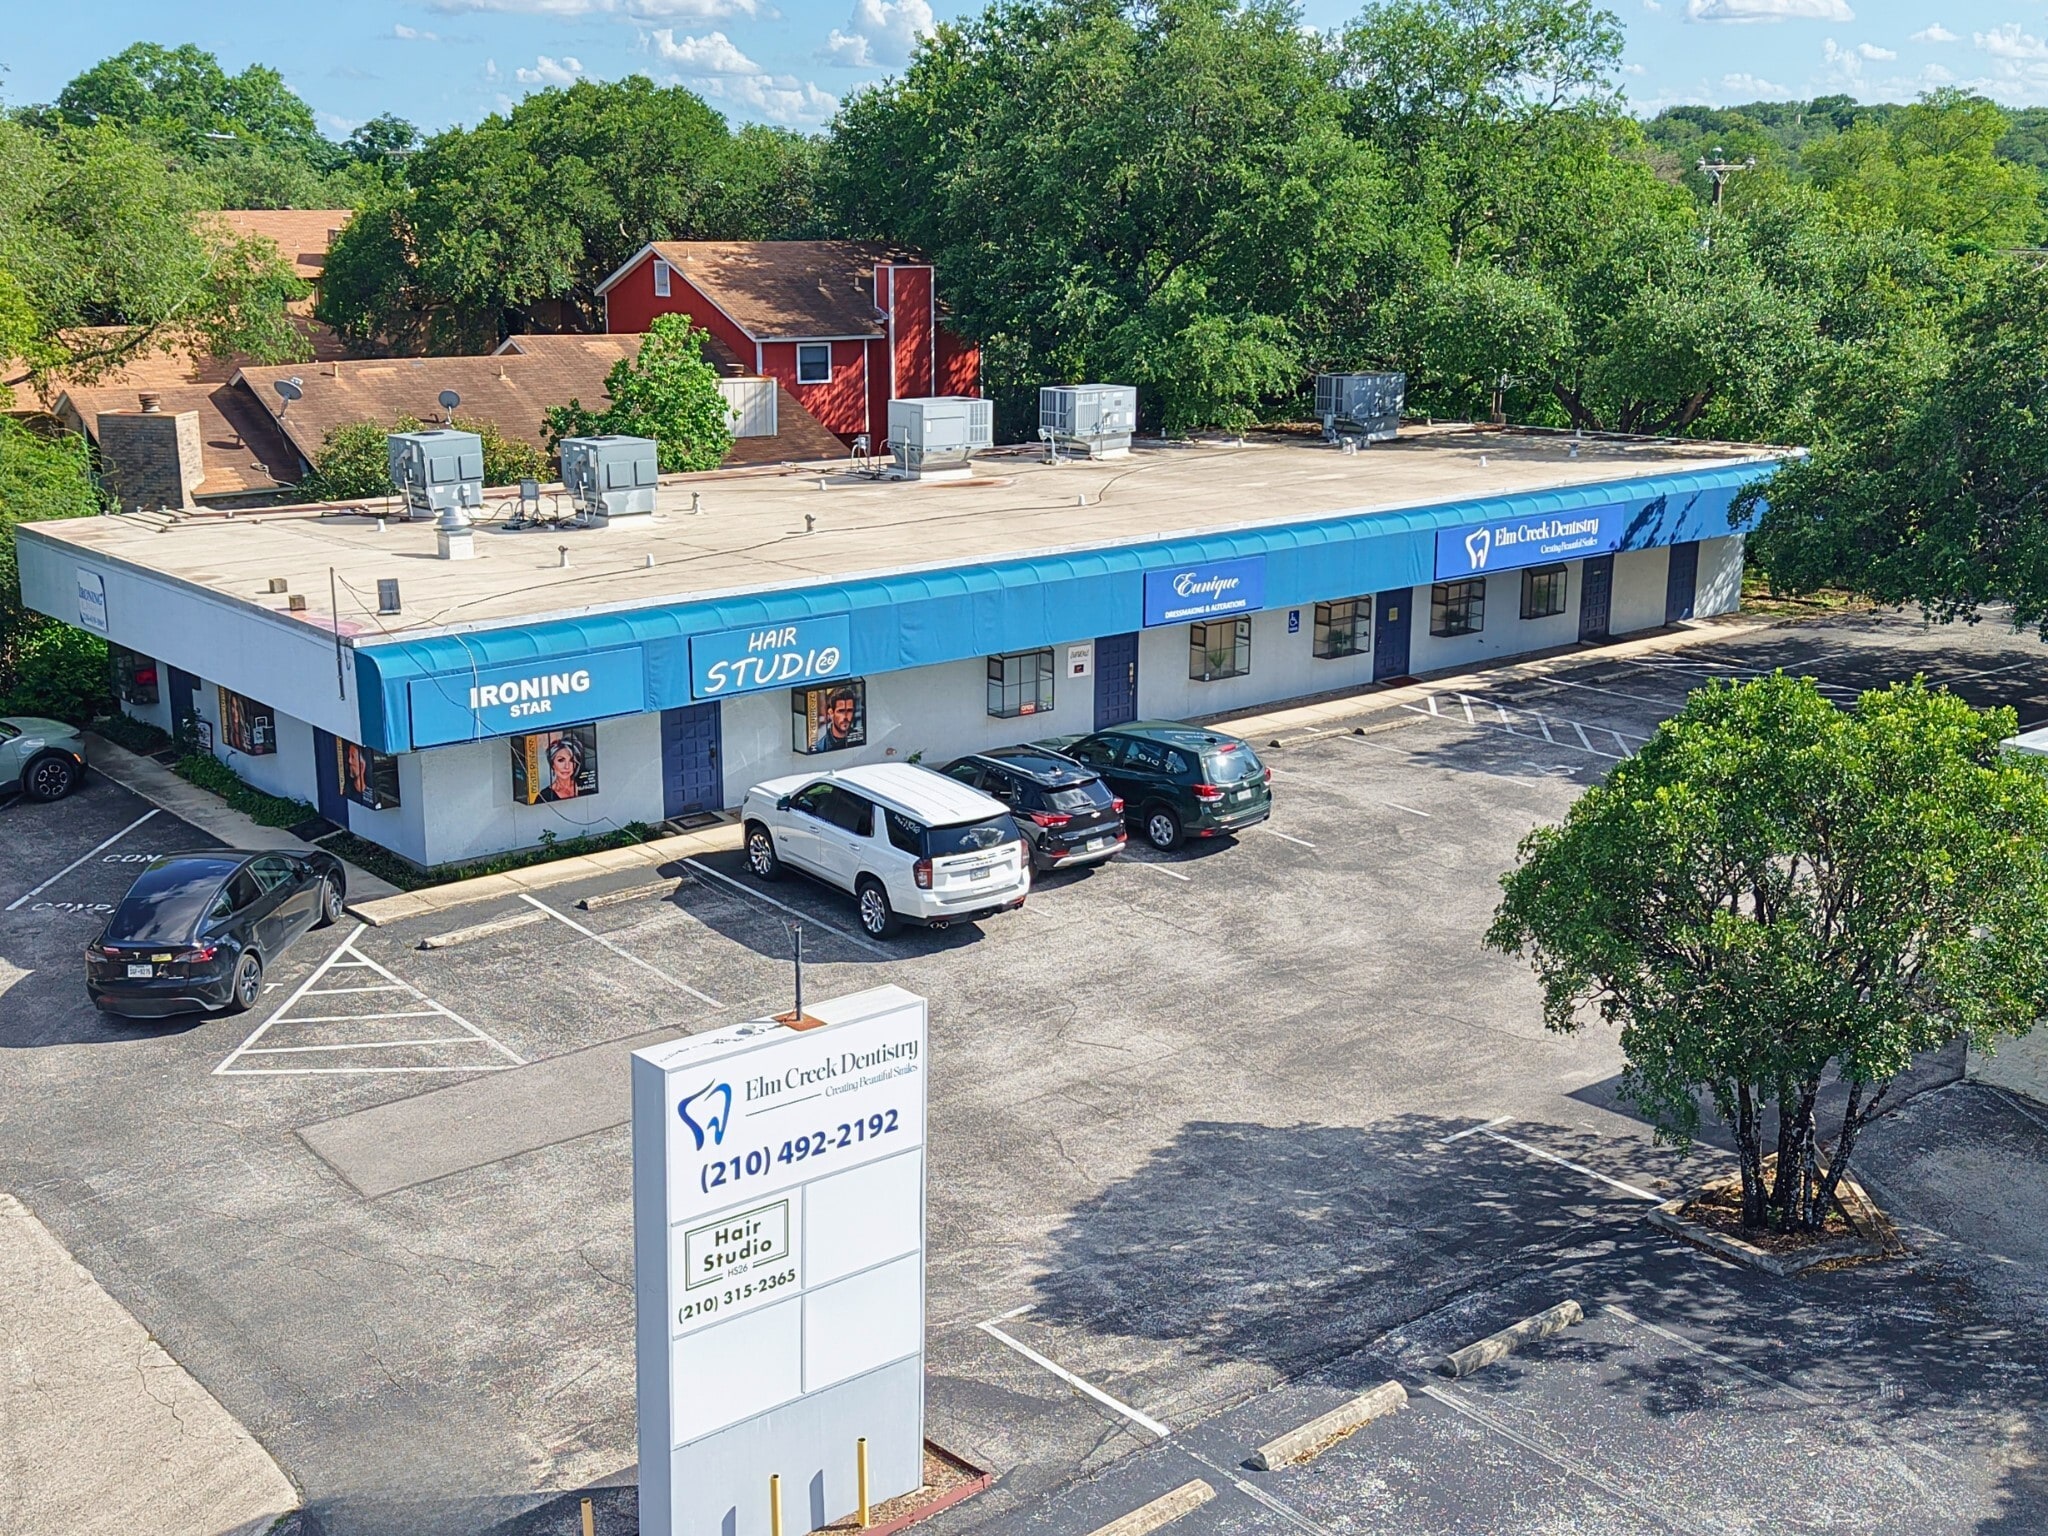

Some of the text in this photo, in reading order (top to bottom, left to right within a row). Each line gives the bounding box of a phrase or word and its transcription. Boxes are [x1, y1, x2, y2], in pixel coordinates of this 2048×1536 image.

[1495, 518, 1599, 547] Elm Creek Dentistry
[1173, 572, 1240, 600] Eunique
[1165, 605, 1205, 619] DRESSMAKING
[1211, 599, 1247, 611] ALTERATIONS
[748, 626, 797, 653] HAIR
[704, 646, 840, 693] STUDIO
[819, 655, 835, 666] 26
[470, 670, 590, 709] IRONING
[510, 699, 552, 718] STAR
[745, 1040, 918, 1102] Elm Creek Dentistry
[825, 1062, 918, 1097] Creating Beautiful Smiles
[701, 1109, 899, 1194] (210) 492-2192
[715, 1219, 761, 1247] Hair
[703, 1238, 772, 1272] Studio
[727, 1264, 749, 1278] HS26
[678, 1268, 796, 1325] (210) 315-2365
